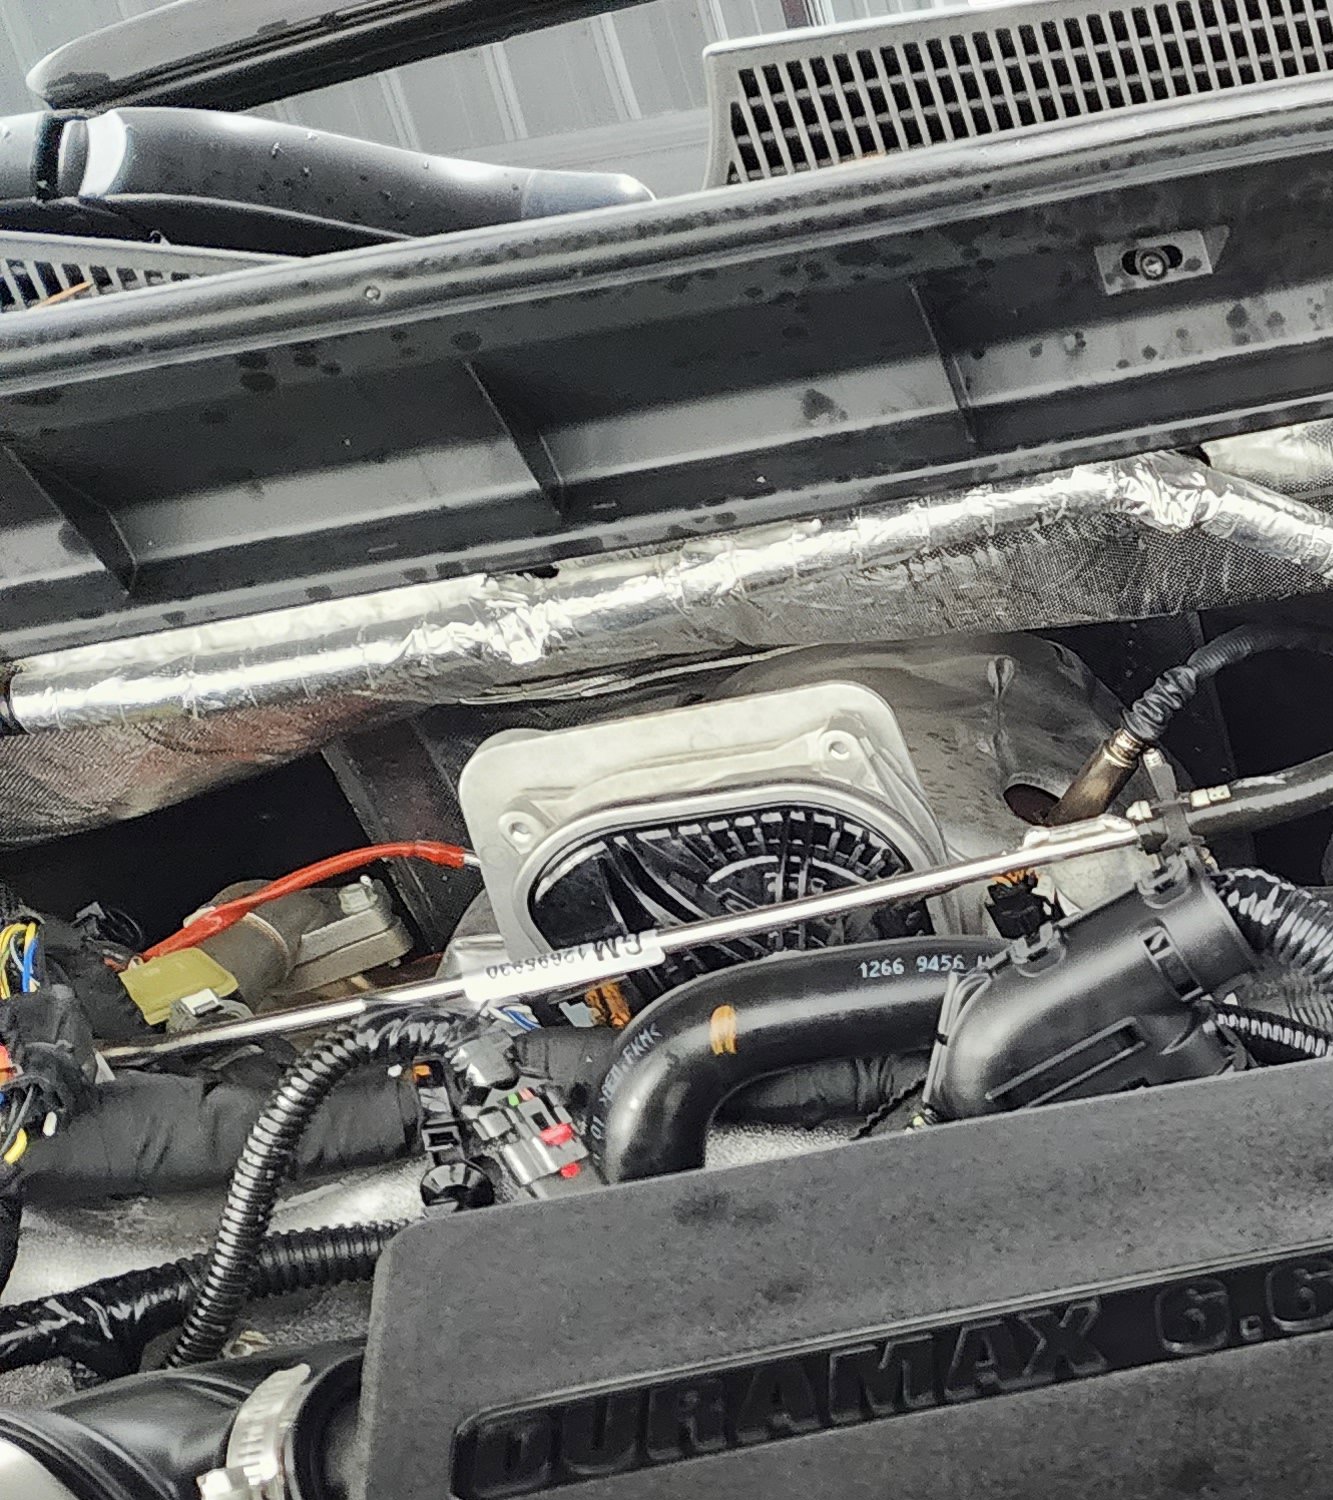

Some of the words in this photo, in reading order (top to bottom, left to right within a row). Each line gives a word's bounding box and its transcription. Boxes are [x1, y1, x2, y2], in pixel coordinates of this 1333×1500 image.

[592, 934, 644, 962] GM
[858, 958, 905, 979] 1266
[916, 953, 966, 973] 9456
[466, 1296, 1106, 1498] DURAMAX
